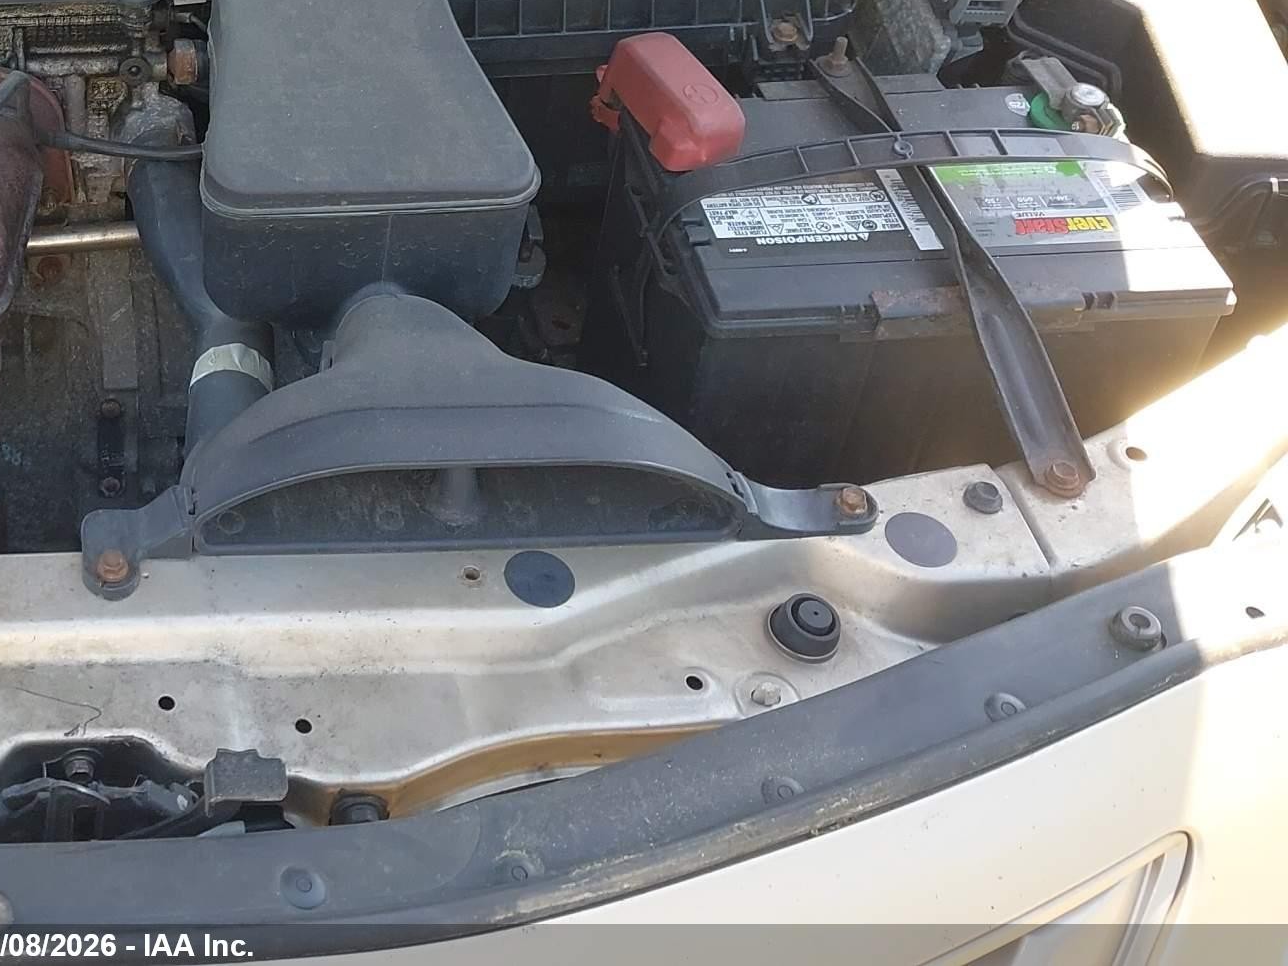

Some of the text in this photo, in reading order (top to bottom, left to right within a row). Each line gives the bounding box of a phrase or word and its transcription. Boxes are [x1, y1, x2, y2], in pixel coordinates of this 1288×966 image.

[1016, 210, 1045, 218] VALUE
[1015, 216, 1113, 235] EverStart
[756, 233, 858, 245] DANGER/POISON
